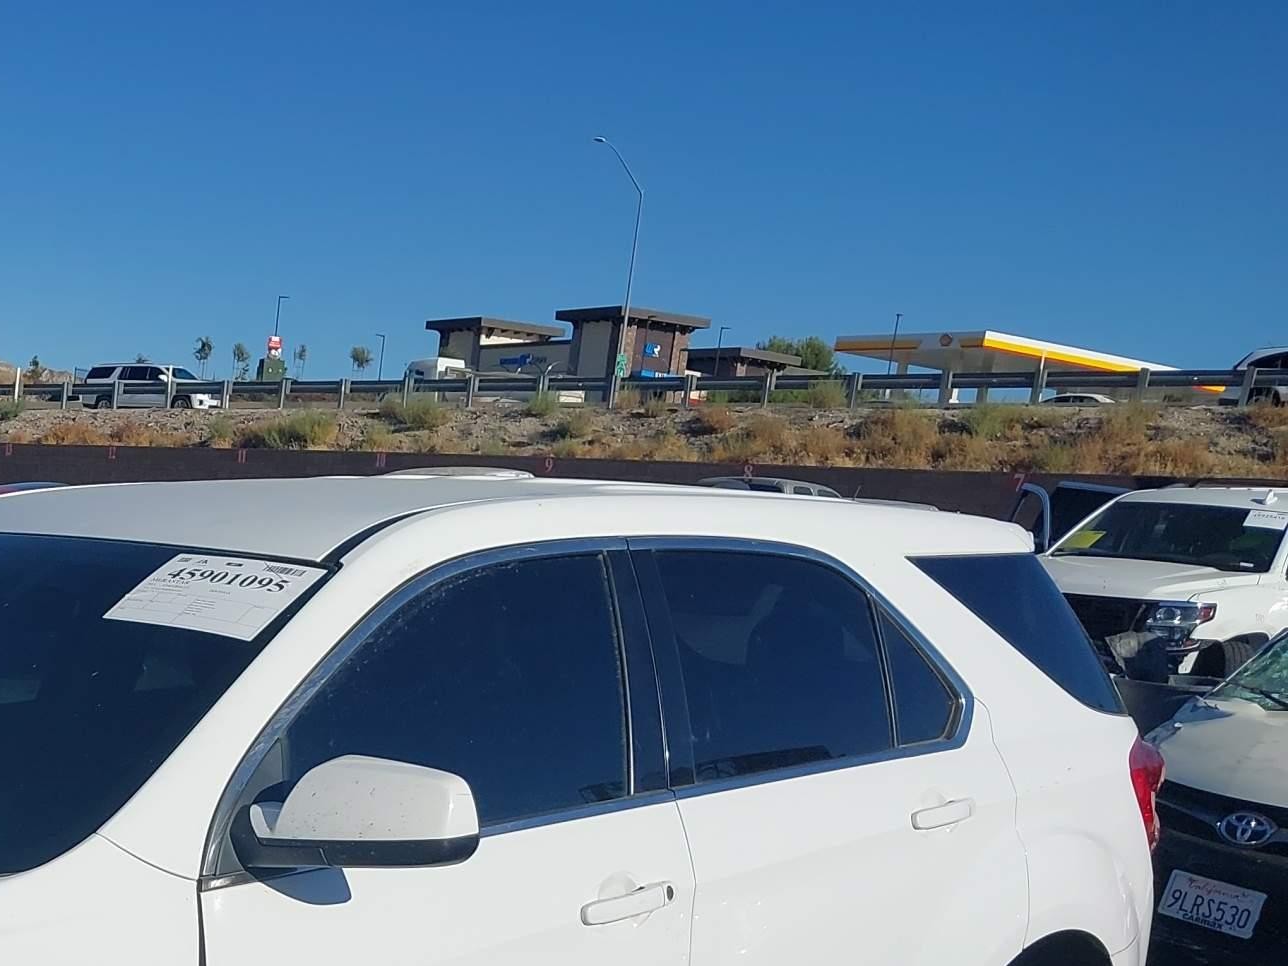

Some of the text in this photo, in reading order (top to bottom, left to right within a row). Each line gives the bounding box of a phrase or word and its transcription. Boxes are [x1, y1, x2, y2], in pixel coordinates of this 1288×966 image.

[544, 457, 553, 472] 9
[1014, 473, 1025, 493] 7
[168, 567, 291, 593] 45901095
[1167, 888, 1251, 929] 9LRS530
